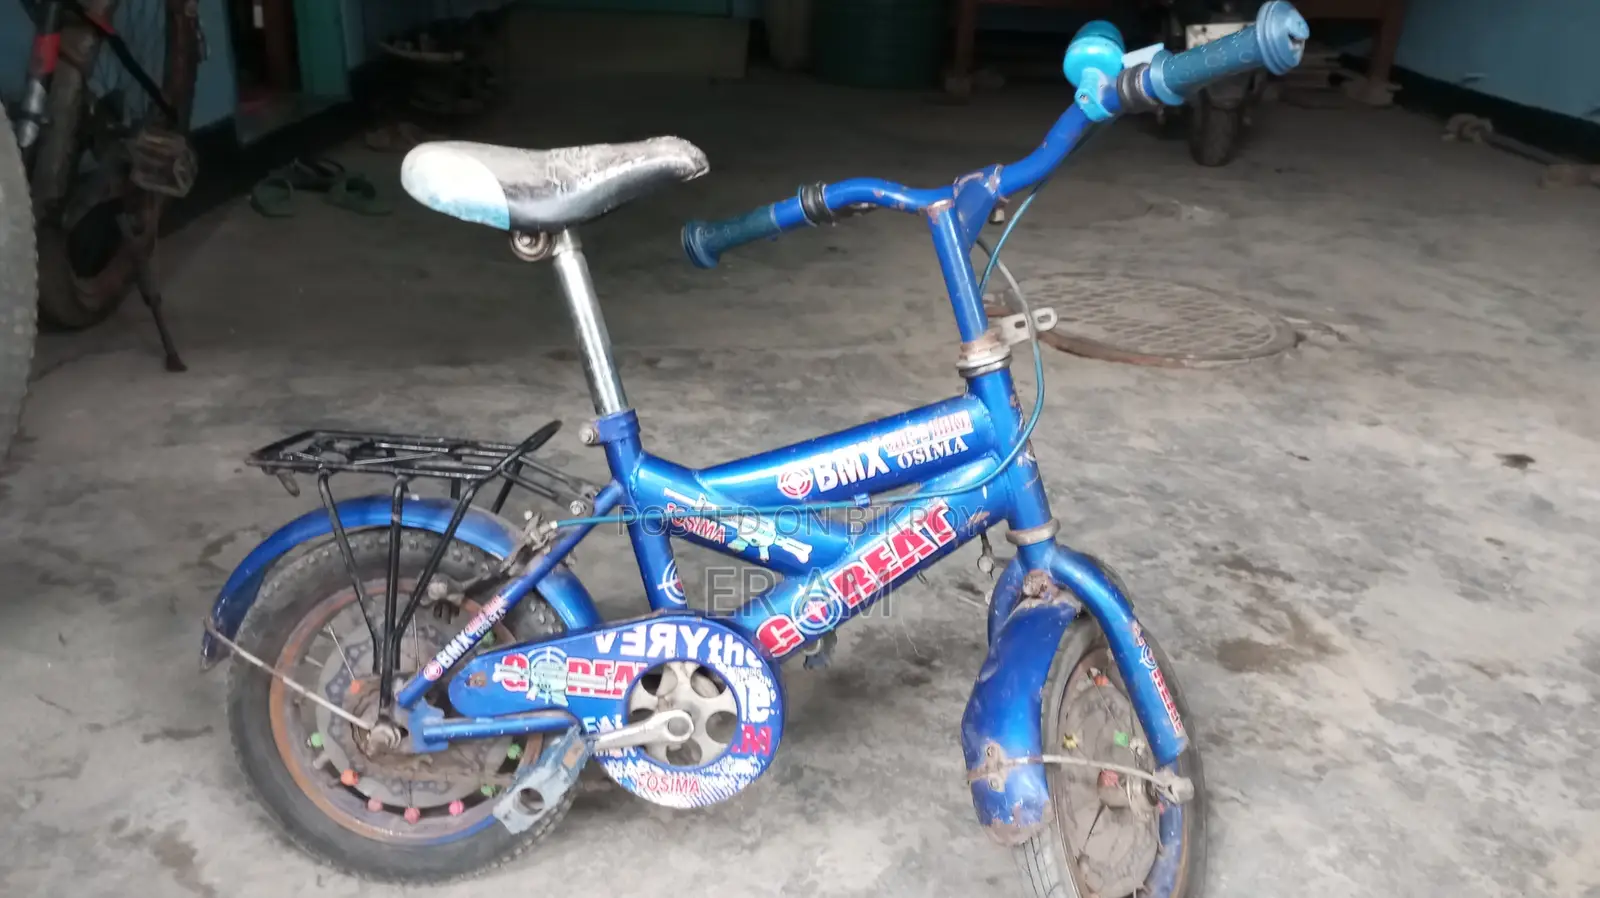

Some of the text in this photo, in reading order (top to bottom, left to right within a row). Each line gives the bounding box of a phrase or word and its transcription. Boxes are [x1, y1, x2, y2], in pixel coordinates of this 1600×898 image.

[812, 437, 891, 492] BMX
[897, 436, 969, 469] OSIMA
[436, 629, 475, 670] BMX
